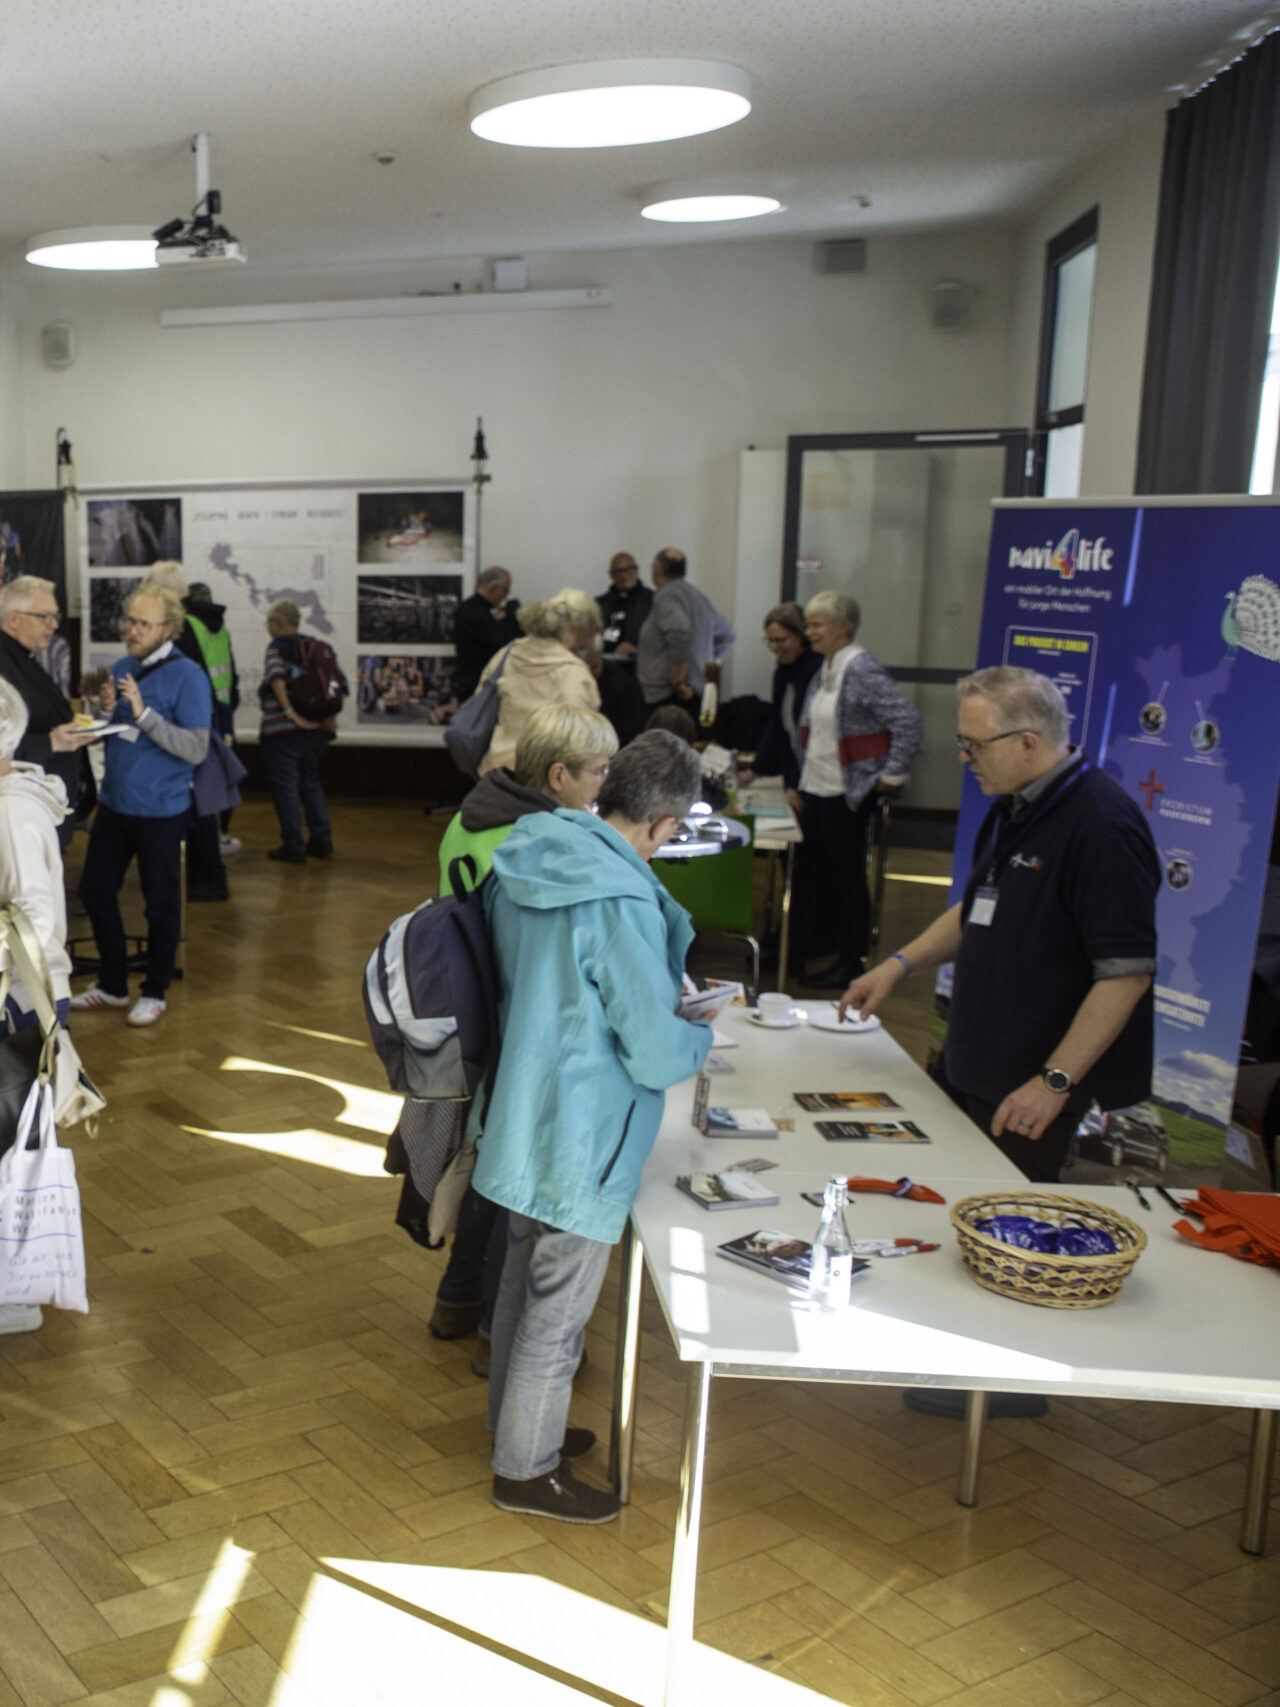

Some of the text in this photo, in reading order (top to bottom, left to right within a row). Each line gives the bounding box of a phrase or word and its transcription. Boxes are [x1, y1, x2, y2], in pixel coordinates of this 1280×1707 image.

[1008, 528, 1114, 579] navi4life
[1074, 587, 1112, 601] Hoffnung
[1051, 600, 1091, 612] Menschen
